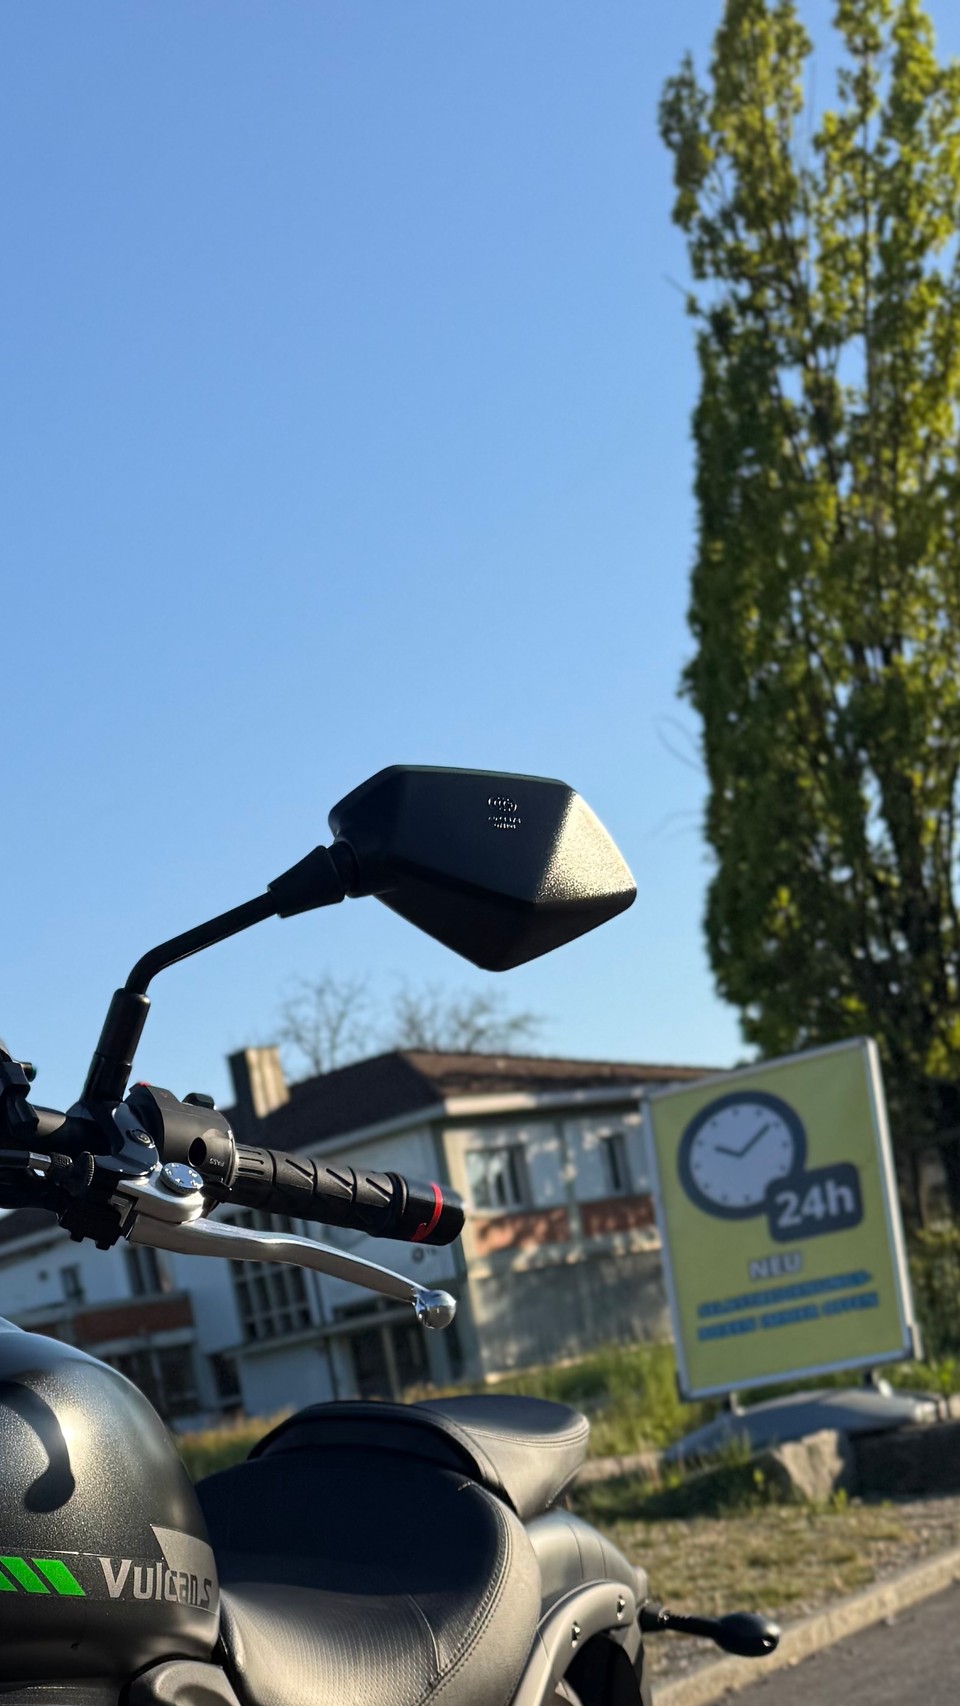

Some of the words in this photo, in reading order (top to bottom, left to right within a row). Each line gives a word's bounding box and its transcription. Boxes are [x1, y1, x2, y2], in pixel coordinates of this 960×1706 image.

[776, 1179, 854, 1228] 24h
[749, 1252, 803, 1281] NEU
[98, 1557, 198, 1605] Vulcan
